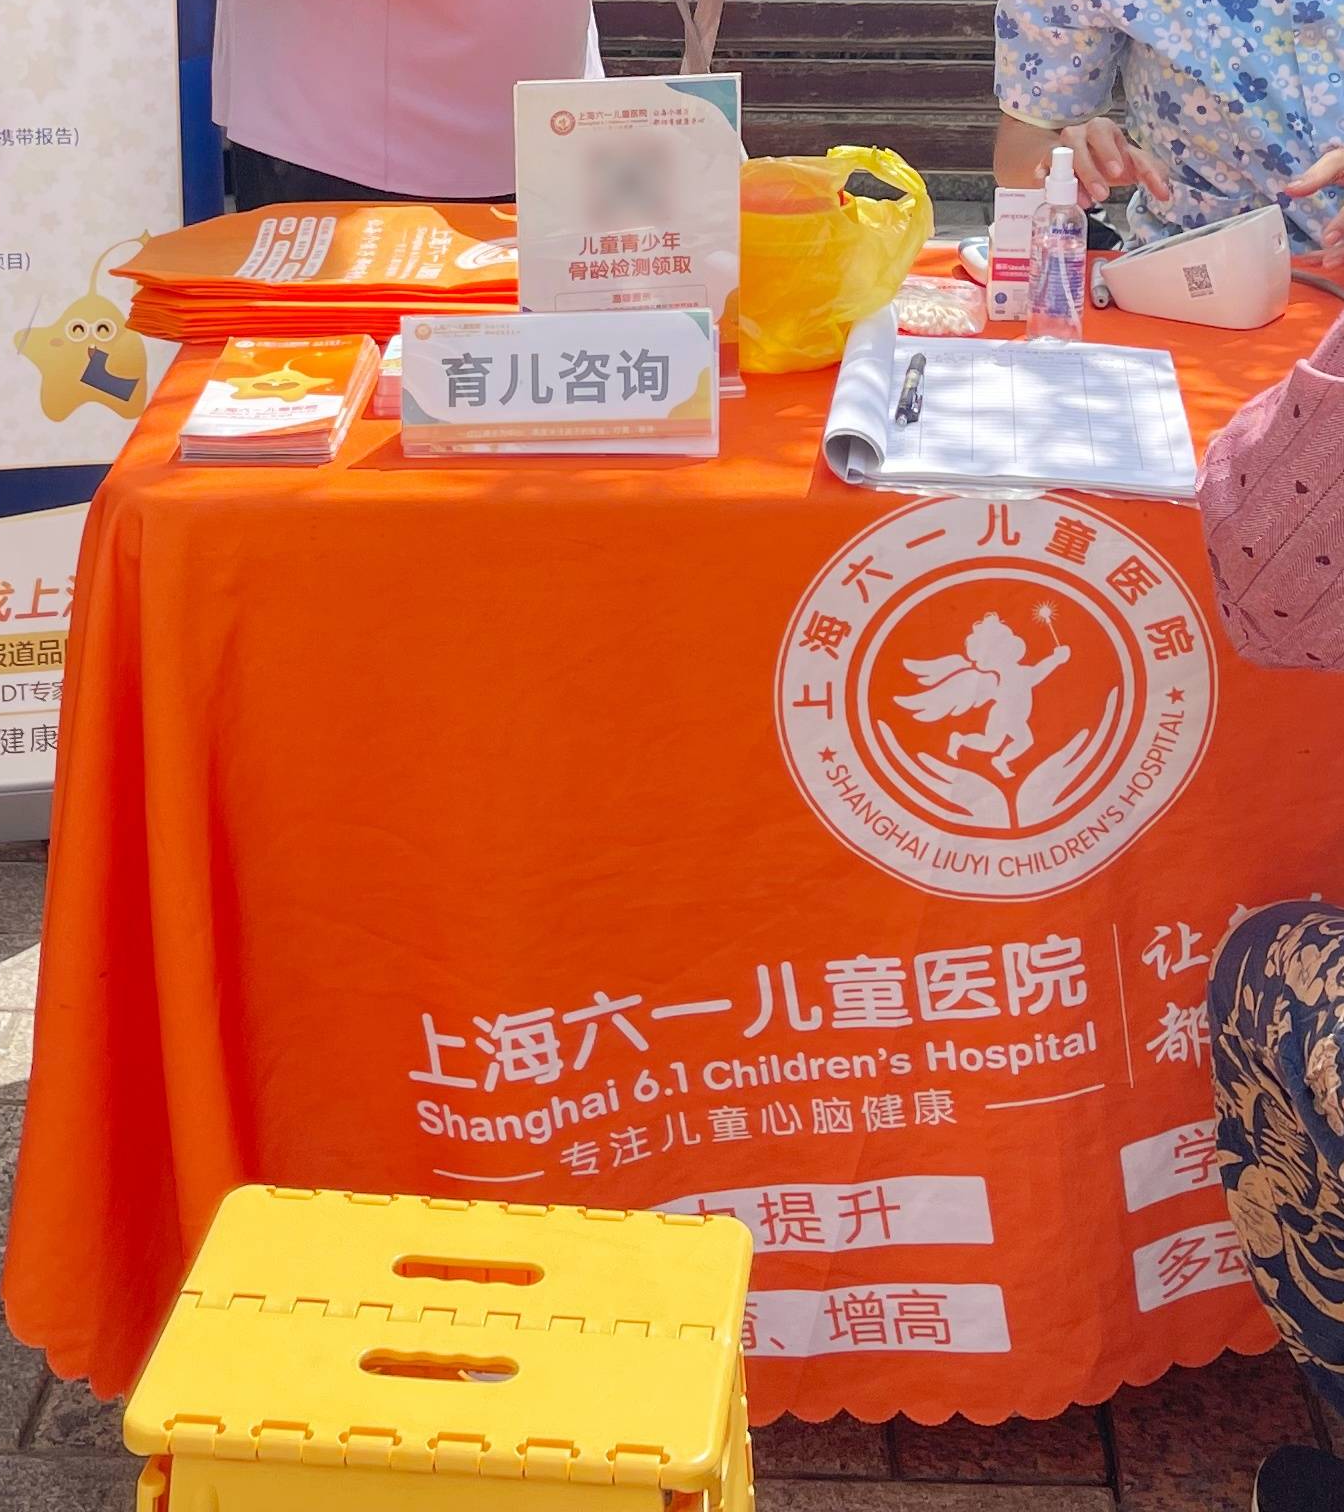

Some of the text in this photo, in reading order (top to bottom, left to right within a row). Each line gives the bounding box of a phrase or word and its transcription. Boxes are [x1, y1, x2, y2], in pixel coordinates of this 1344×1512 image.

[569, 256, 692, 281] 骨龄检测领取
[579, 231, 681, 256] 儿童青少年
[442, 349, 670, 408] 育儿咨询
[793, 504, 1195, 720] 上海六一儿童医院
[826, 709, 1185, 877] SHANGHAI LIUYI CHILDREN'S HOSPITAL
[409, 934, 1089, 1094] 上海六一儿童医院
[416, 1080, 619, 1145] Shanghai
[633, 1062, 690, 1102] 6.1
[926, 1021, 1096, 1080] Hospital
[559, 1090, 958, 1179] 专注儿童心脑健康
